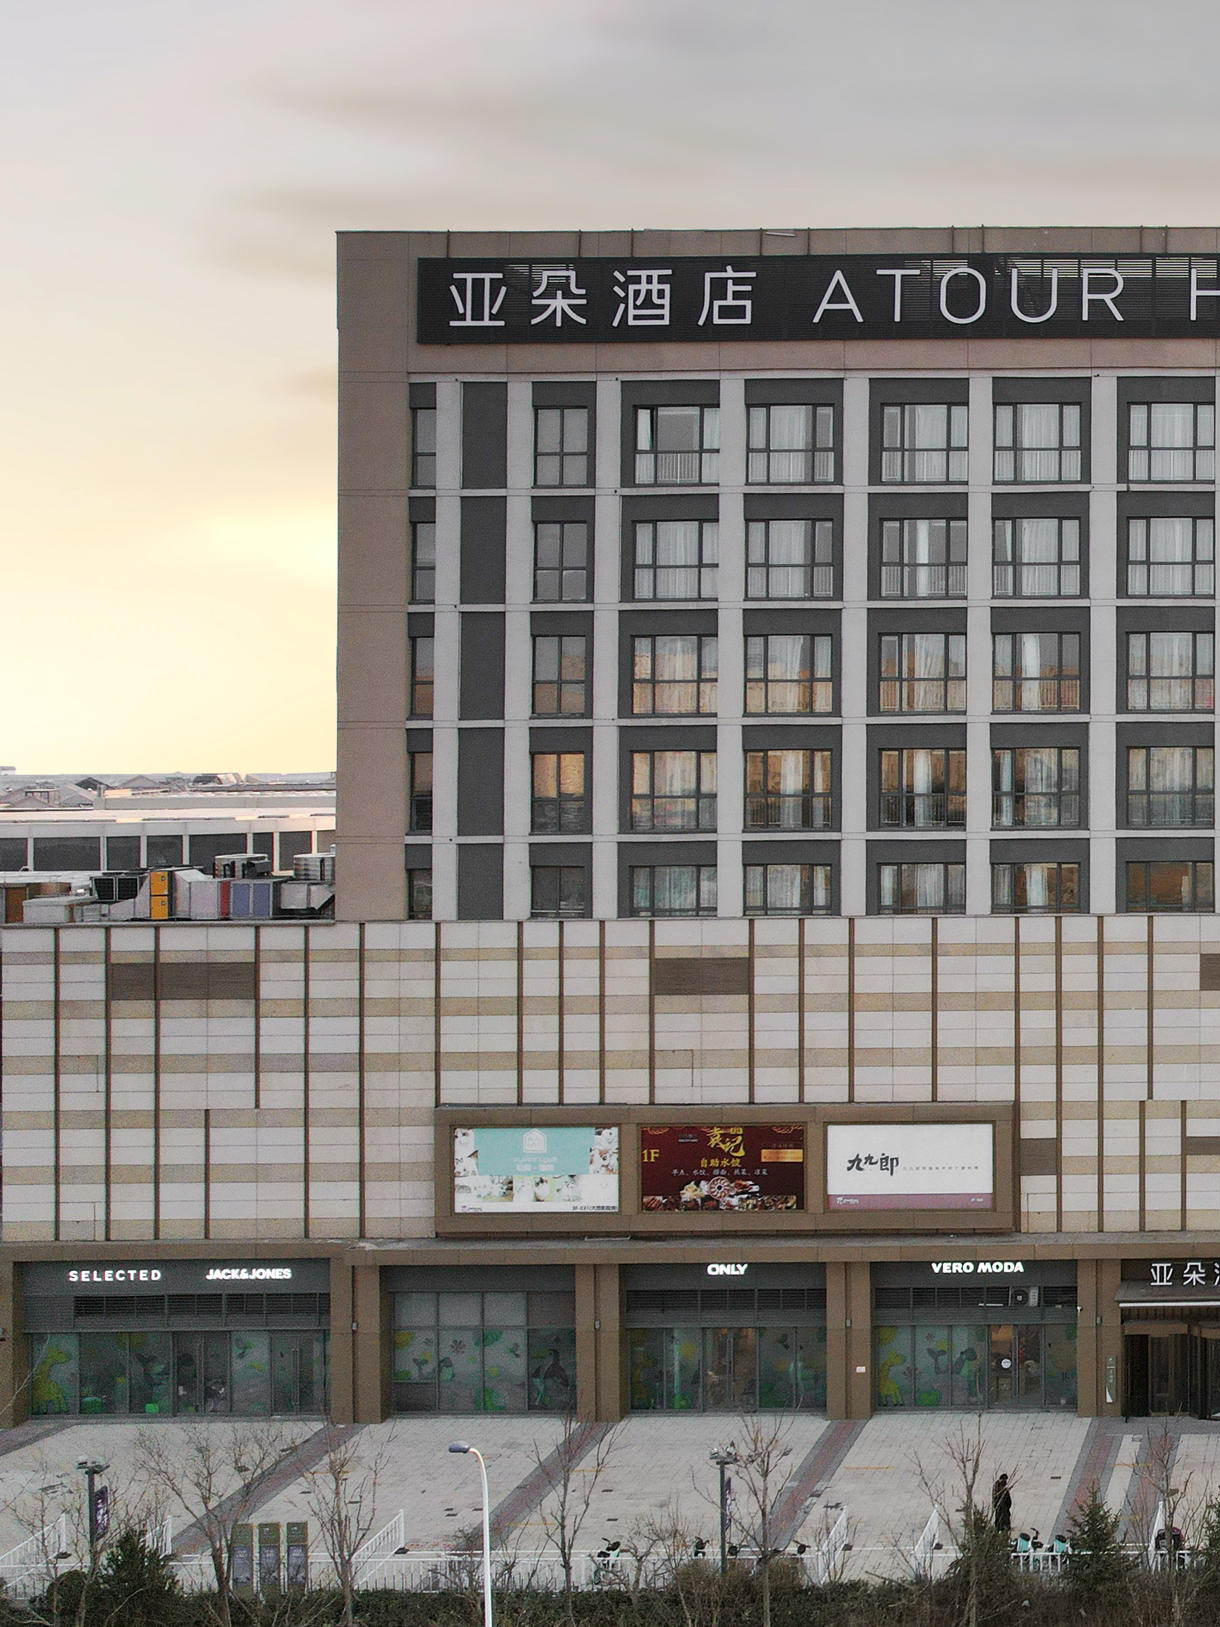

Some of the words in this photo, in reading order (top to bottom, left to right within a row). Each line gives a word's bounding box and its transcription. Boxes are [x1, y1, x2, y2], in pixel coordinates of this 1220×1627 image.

[449, 265, 757, 327] 亚朵酒店
[812, 266, 1124, 324] ATOUR
[642, 1149, 660, 1162] 1F
[205, 1267, 292, 1280] JACK&JONES
[706, 1263, 748, 1276] ONLY
[931, 1262, 974, 1274] VERO
[977, 1261, 1024, 1273] MODA
[68, 1269, 162, 1282] SELECTED
